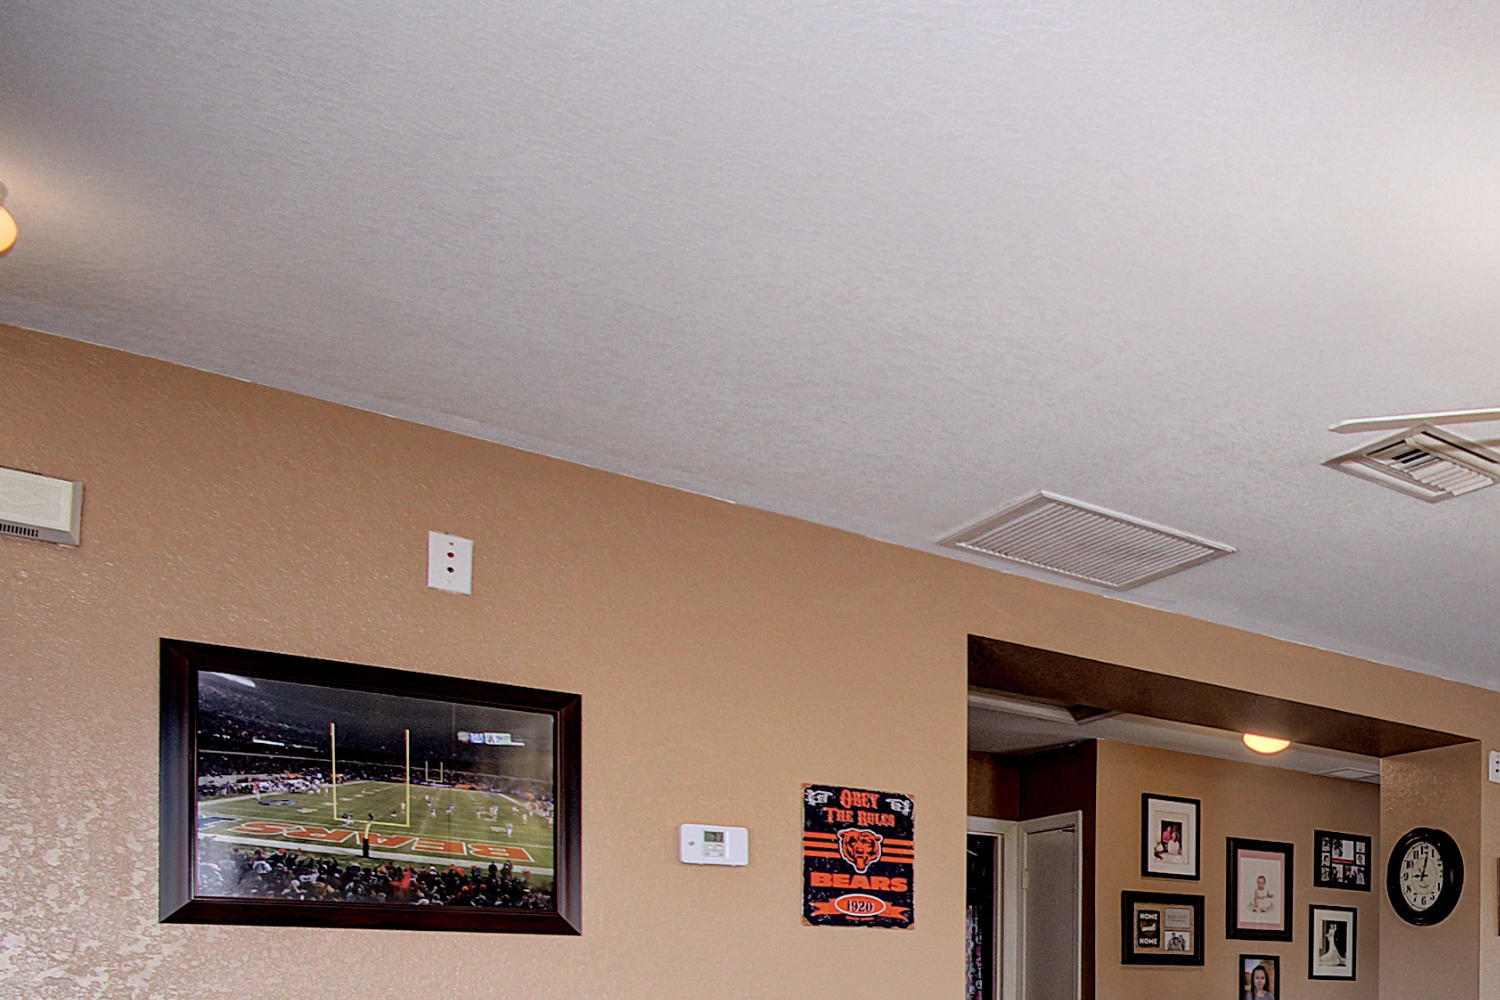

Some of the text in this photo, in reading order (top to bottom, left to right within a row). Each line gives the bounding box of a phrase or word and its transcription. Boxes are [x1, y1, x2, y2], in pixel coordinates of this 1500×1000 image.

[840, 789, 880, 810] OBEY
[809, 872, 909, 892] BEARS
[846, 900, 875, 912] 1920
